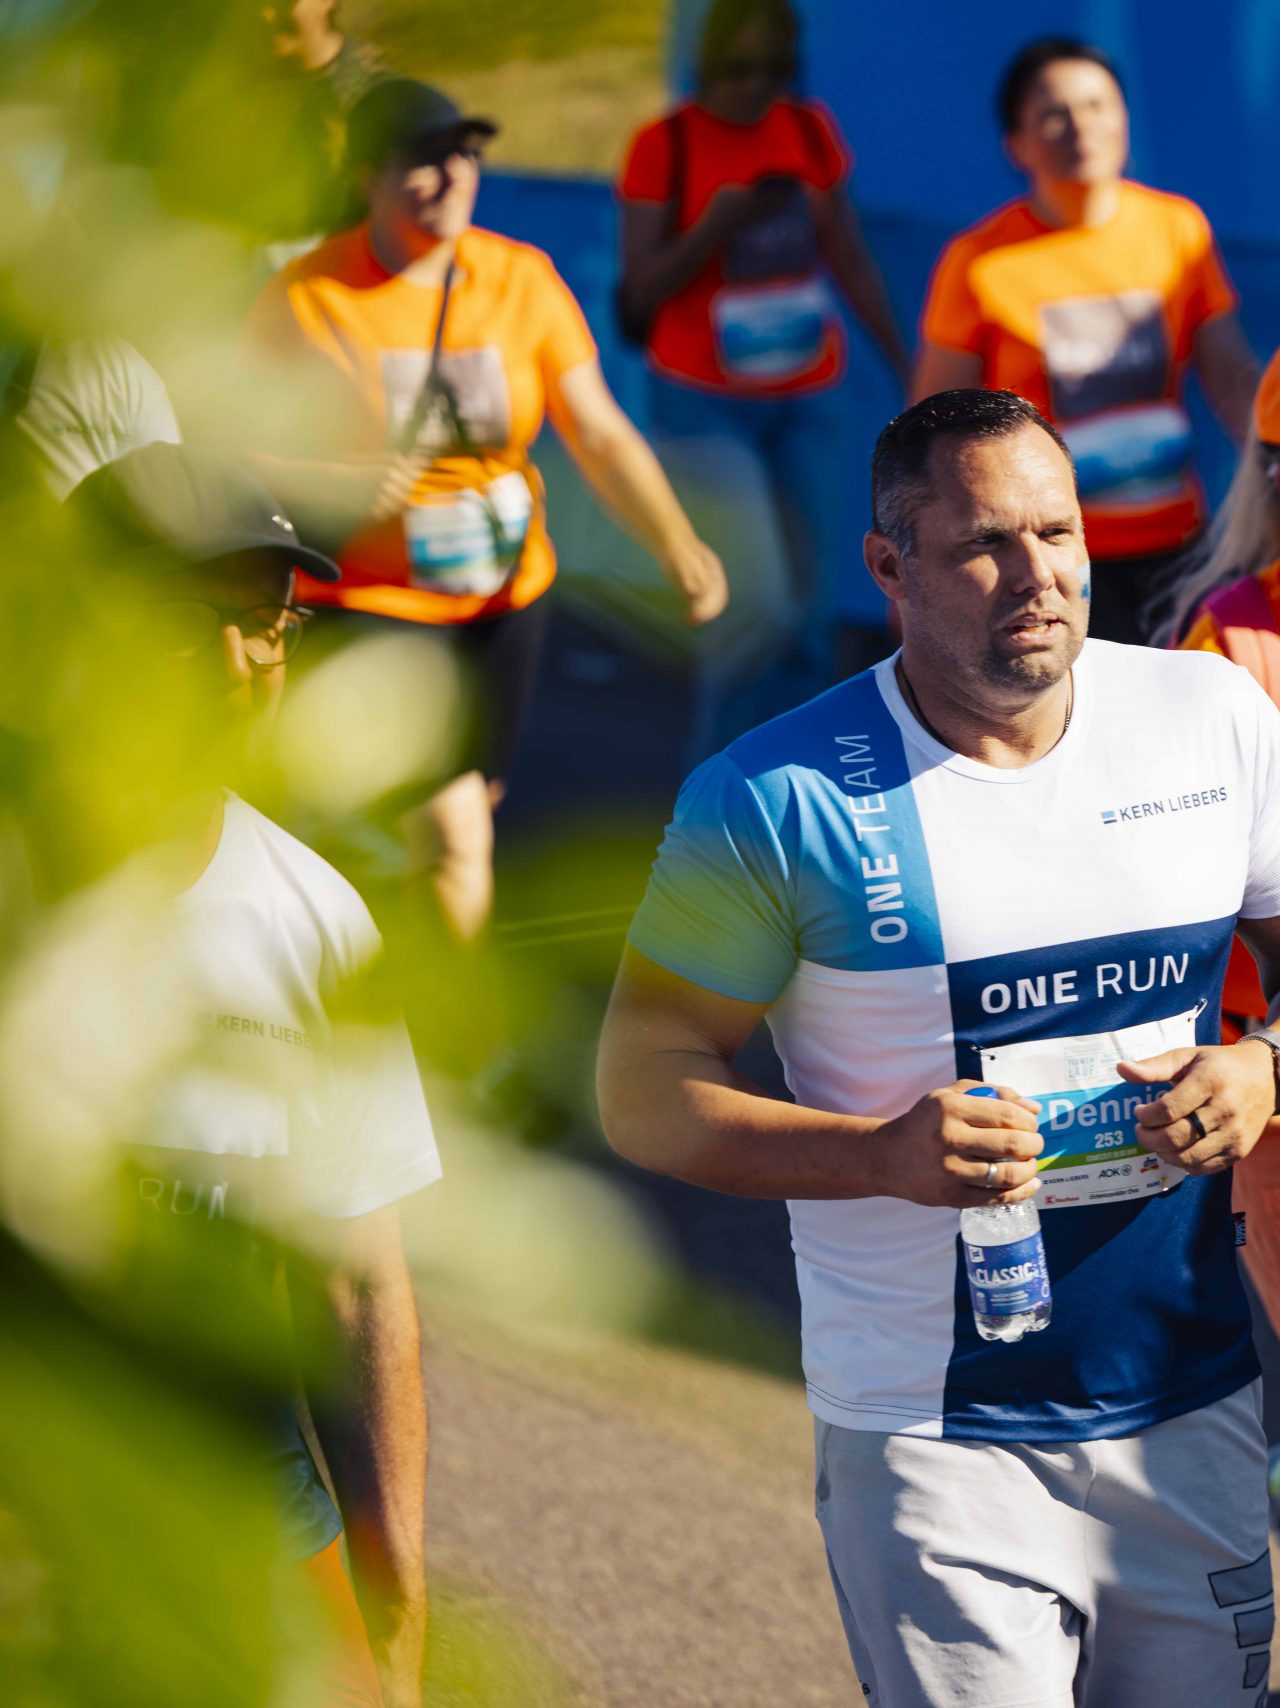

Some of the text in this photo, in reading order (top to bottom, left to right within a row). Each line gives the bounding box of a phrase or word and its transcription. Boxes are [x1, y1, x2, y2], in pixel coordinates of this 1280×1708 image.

[1119, 787, 1228, 821] KERN LIEBERS
[834, 734, 909, 944] ONE TEAM
[981, 953, 1189, 1014] ONE RUN
[216, 1014, 265, 1037] KERN
[1094, 1130, 1123, 1149] 253
[1098, 1166, 1121, 1180] AOK
[139, 1178, 229, 1220] RUN
[975, 1262, 1034, 1283] CLASSIC
